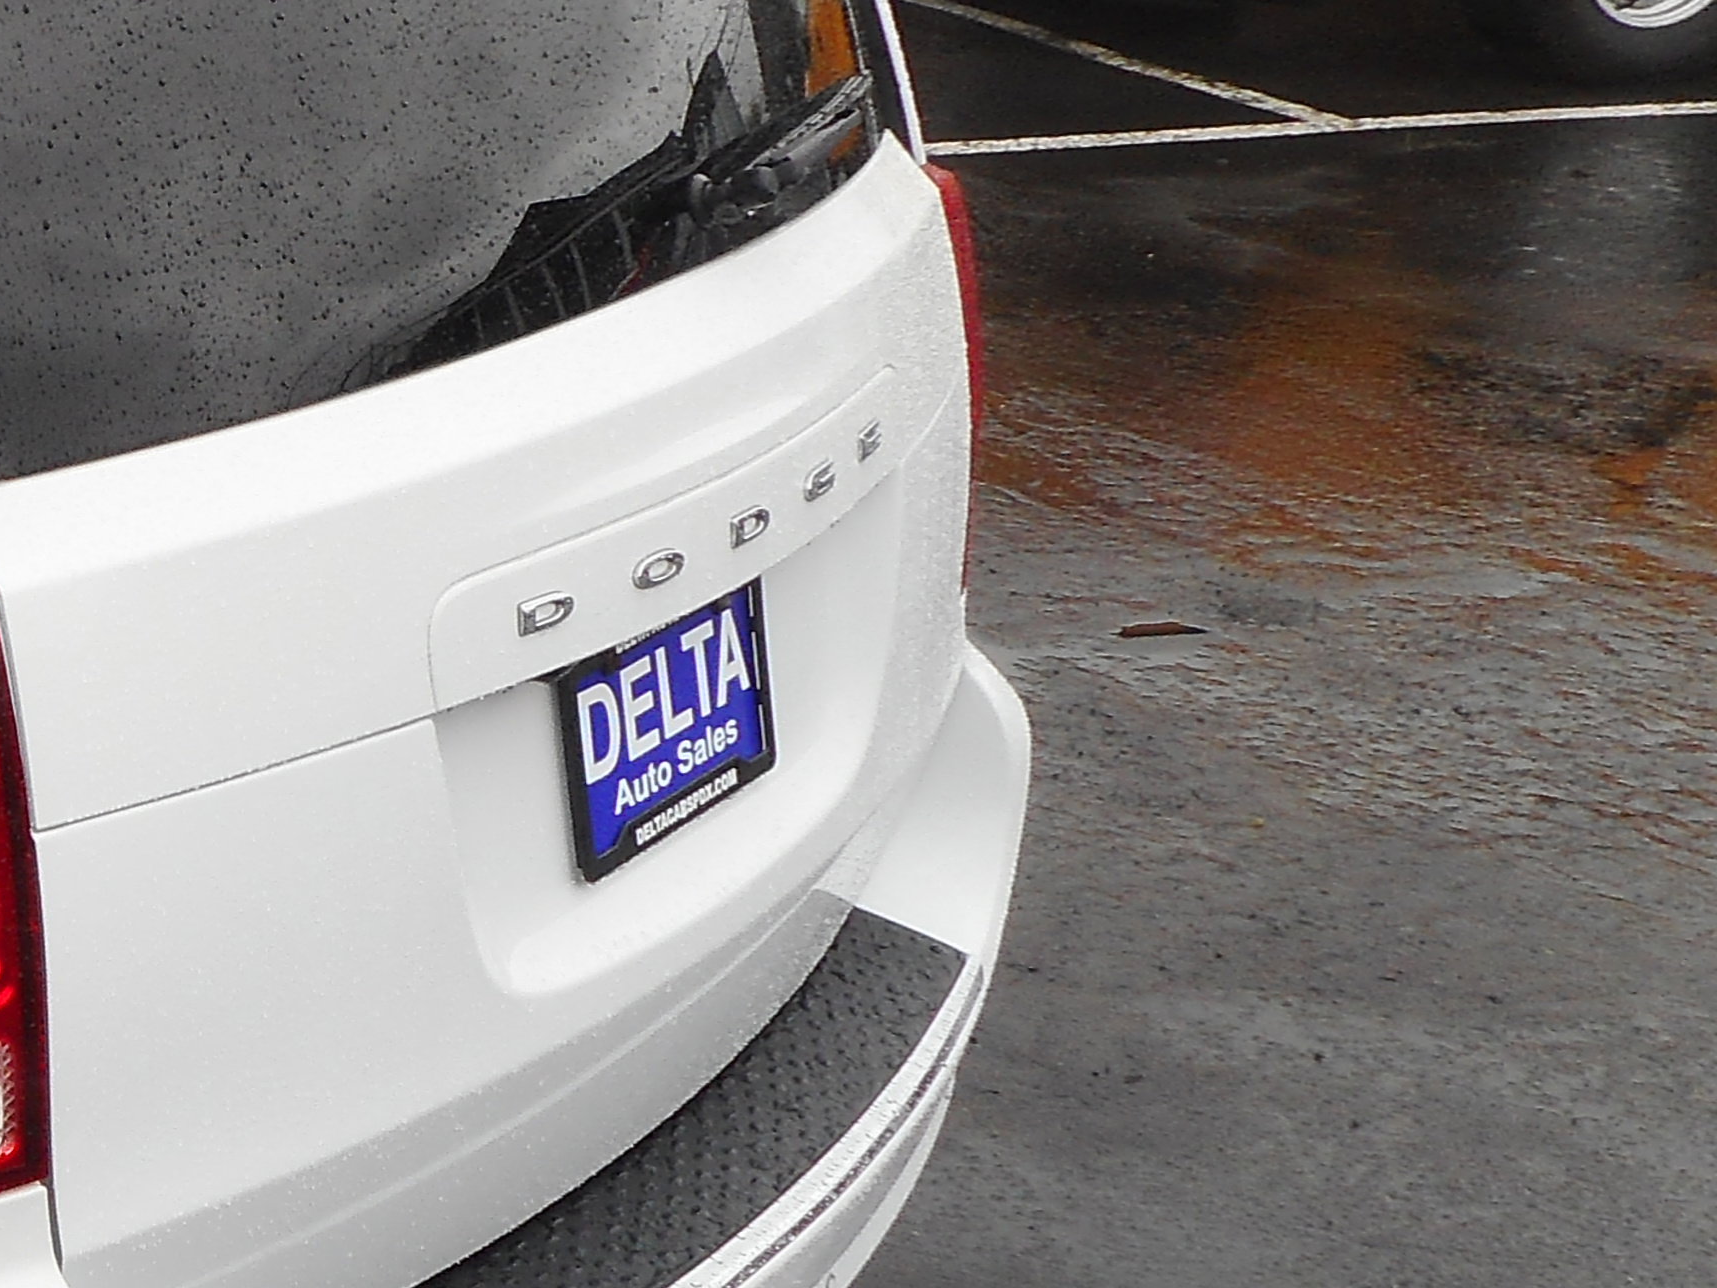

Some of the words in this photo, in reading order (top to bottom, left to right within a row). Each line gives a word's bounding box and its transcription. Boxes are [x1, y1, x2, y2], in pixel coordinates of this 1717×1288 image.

[517, 417, 882, 638] DODGE
[576, 608, 752, 786] DELTA
[614, 761, 672, 816] Auto
[676, 718, 738, 774] Sales
